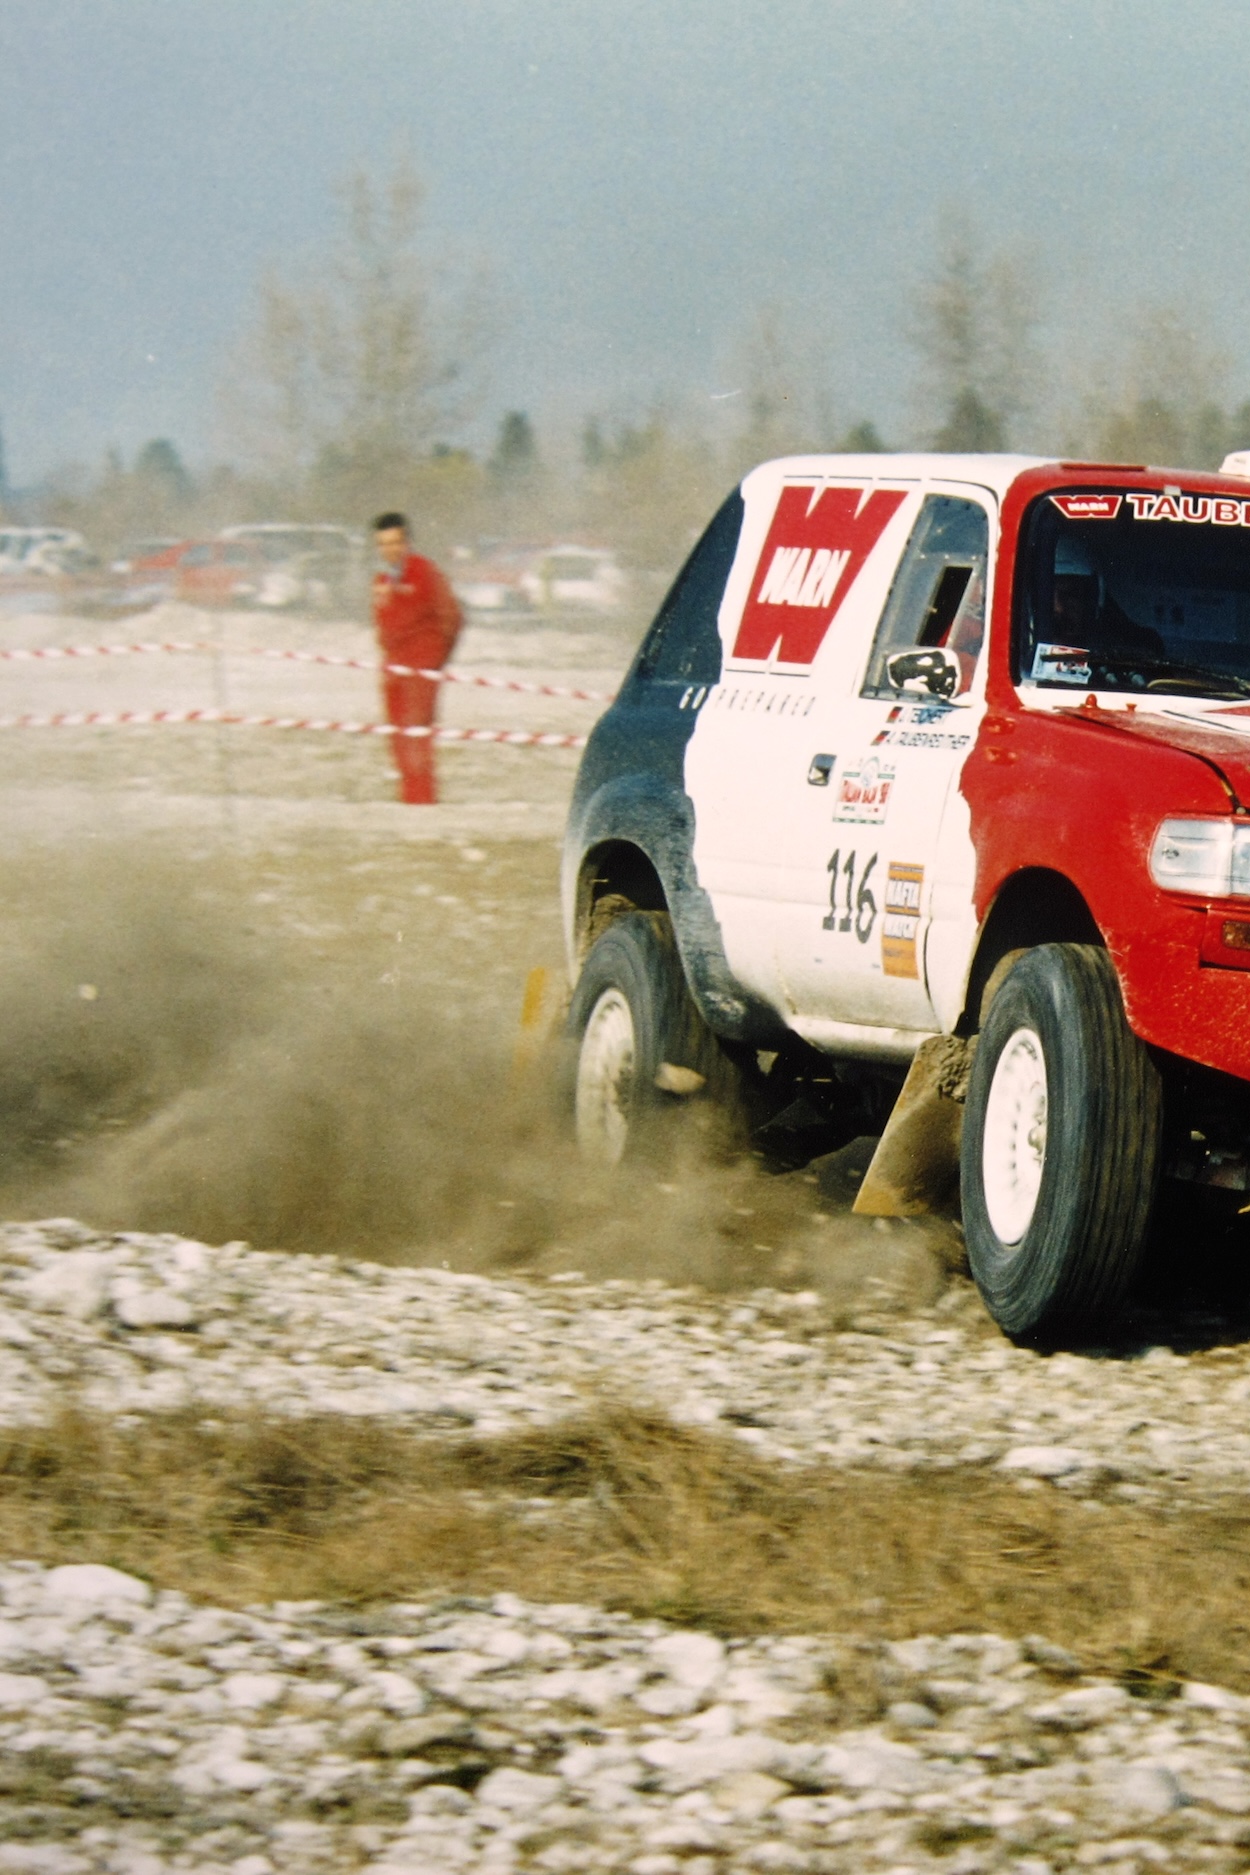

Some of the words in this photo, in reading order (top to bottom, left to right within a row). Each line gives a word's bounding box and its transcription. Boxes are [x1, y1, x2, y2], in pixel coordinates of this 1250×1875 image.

[1067, 502, 1109, 511] WARN
[757, 546, 850, 608] WARN
[715, 688, 816, 717] PREPARED
[822, 848, 878, 944] 116
